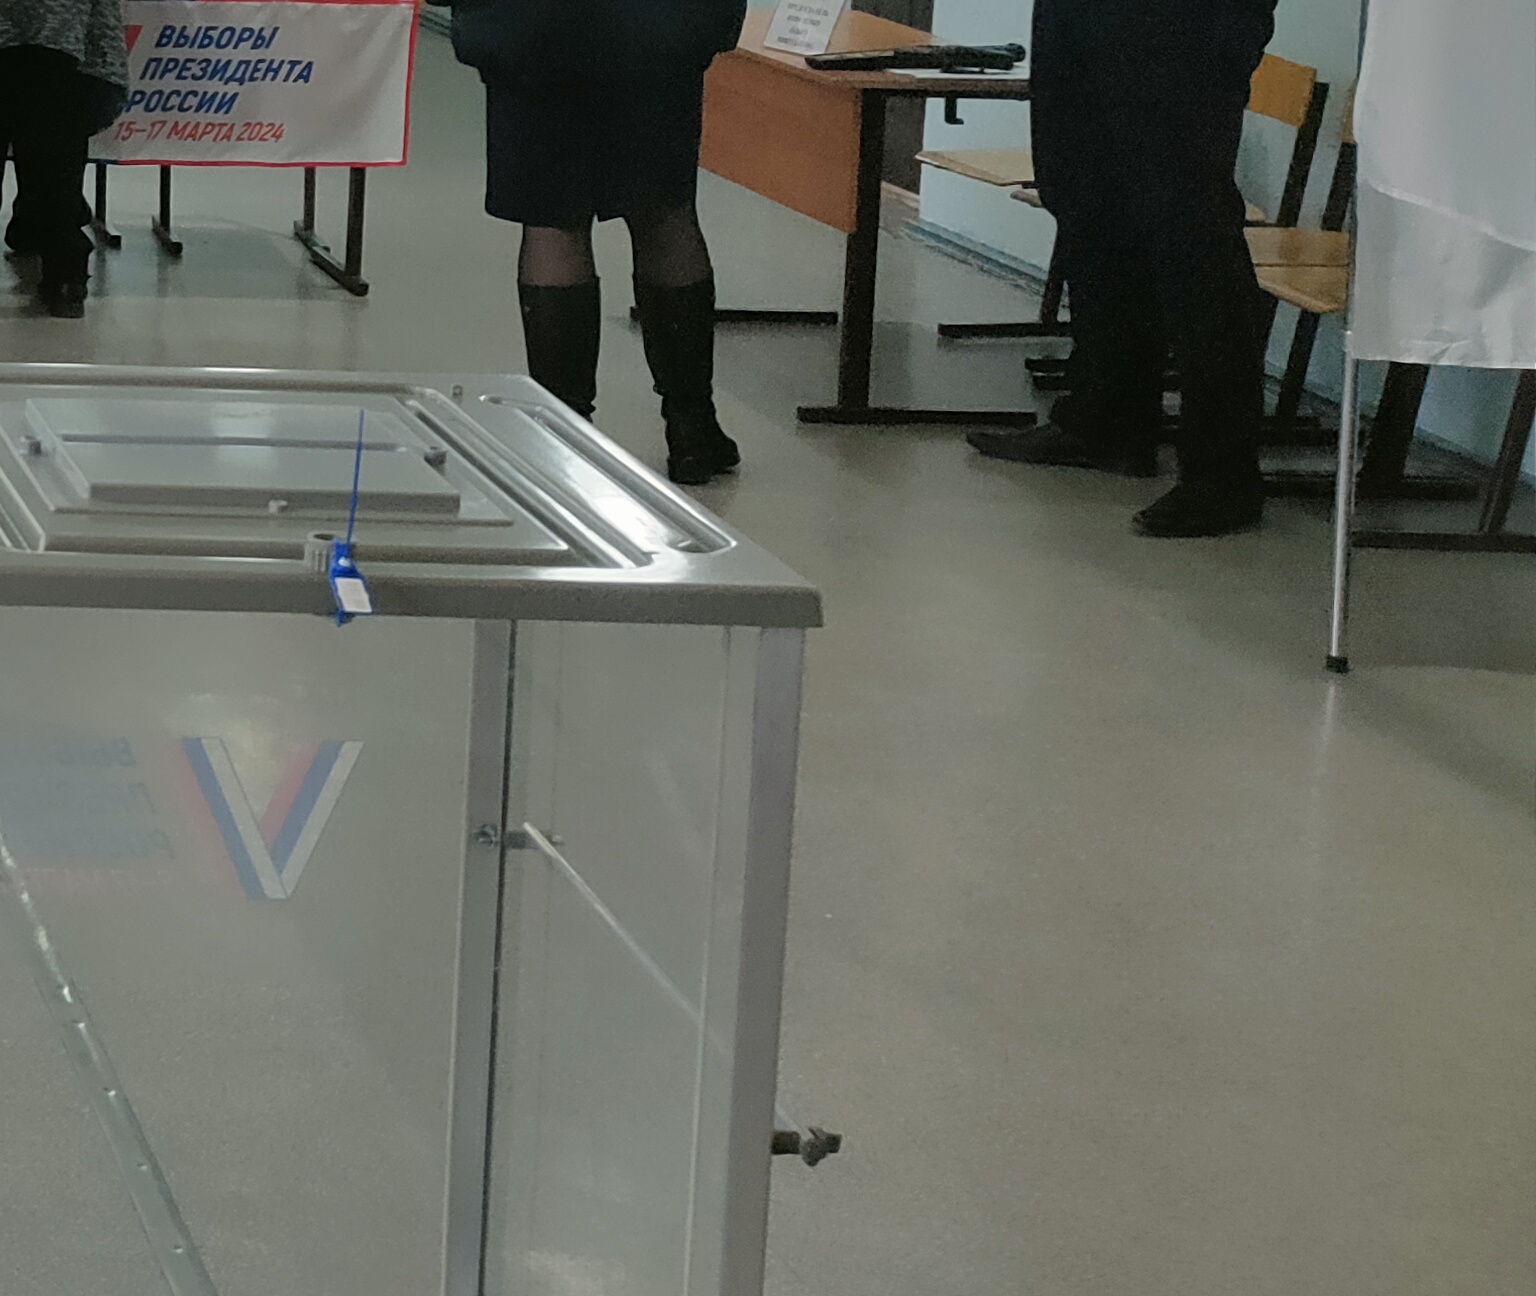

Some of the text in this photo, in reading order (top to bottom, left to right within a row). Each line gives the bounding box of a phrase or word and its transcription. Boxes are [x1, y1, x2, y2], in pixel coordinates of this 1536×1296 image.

[154, 24, 280, 50] ВЫБОРЫ
[139, 57, 314, 86] ПРЕЗИДЕНТА
[125, 90, 240, 115] РОССИИ
[166, 120, 236, 142] МАРТА
[236, 122, 287, 143] 2024
